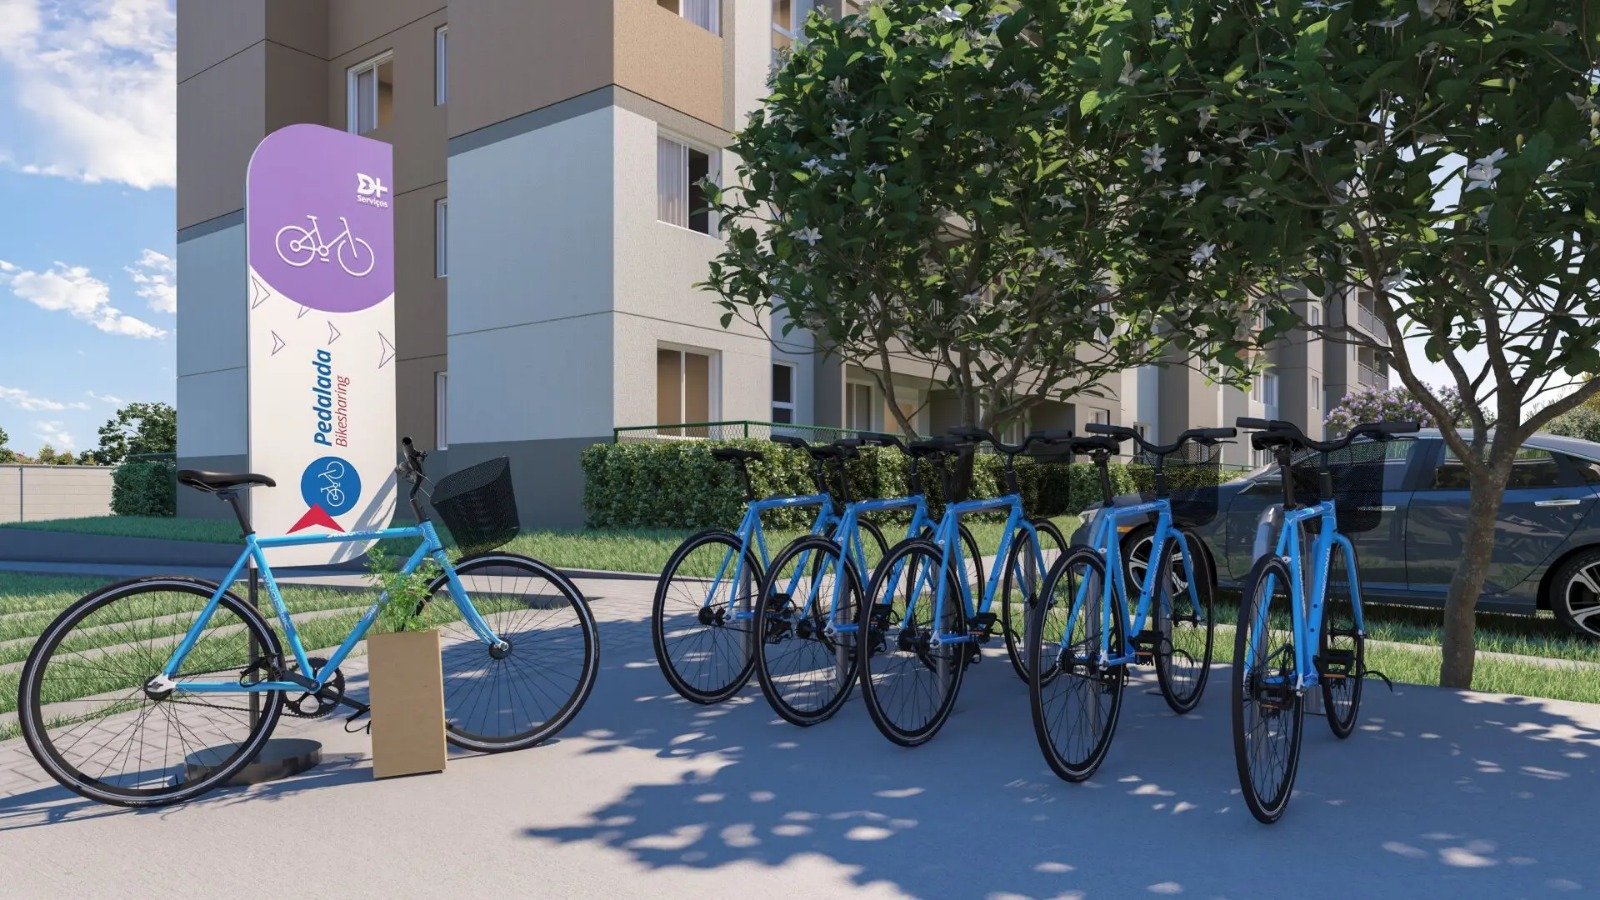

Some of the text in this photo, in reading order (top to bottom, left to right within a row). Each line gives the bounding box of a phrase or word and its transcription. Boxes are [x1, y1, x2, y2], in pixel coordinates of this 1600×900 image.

[357, 194, 388, 208] Serviços
[311, 349, 332, 446] Pedalada
[335, 375, 350, 447] Bikesharing
